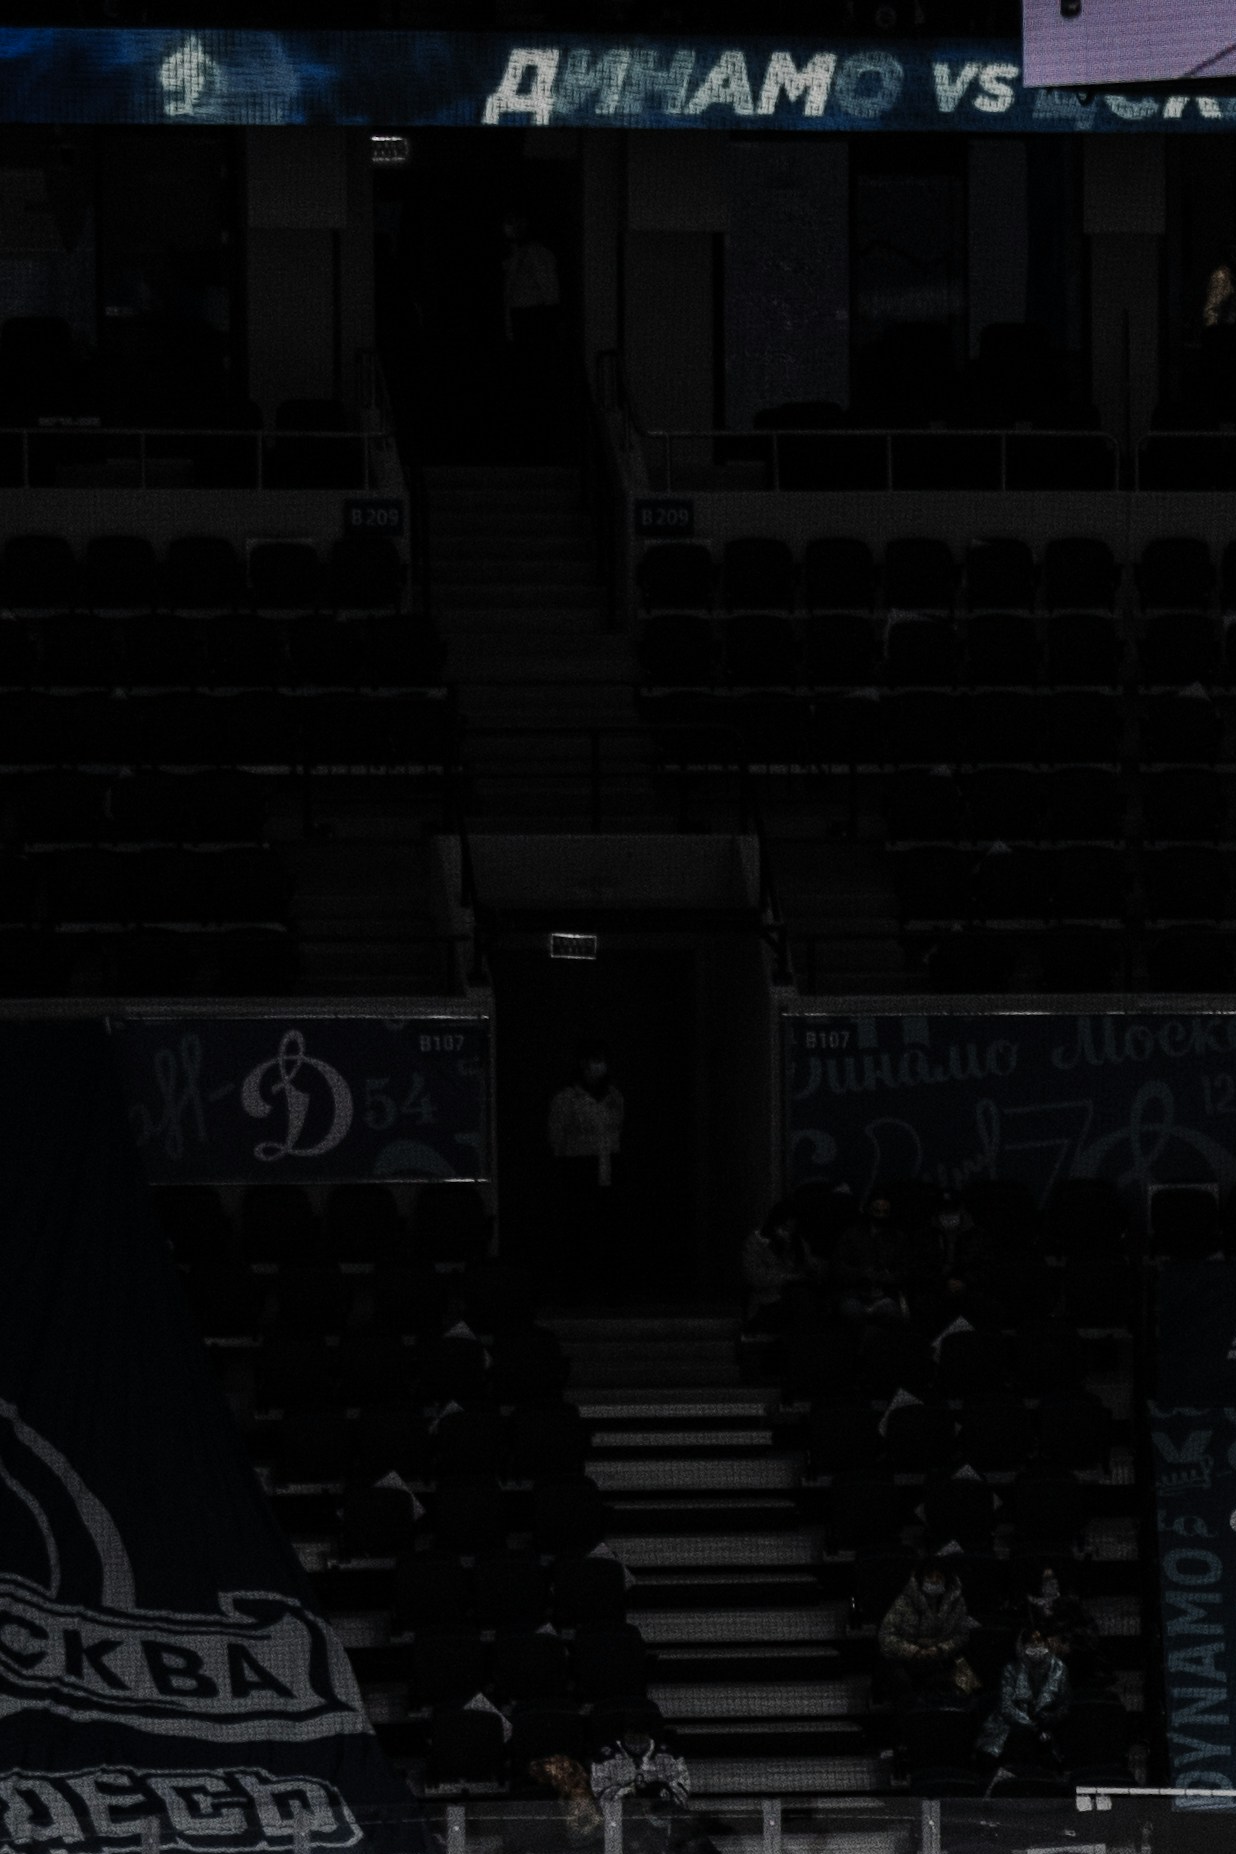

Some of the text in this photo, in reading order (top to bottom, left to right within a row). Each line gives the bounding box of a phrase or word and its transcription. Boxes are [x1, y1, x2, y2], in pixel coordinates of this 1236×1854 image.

[481, 47, 903, 126] ДИНАМО
[419, 1034, 465, 1052] B107
[805, 1031, 851, 1049] B107
